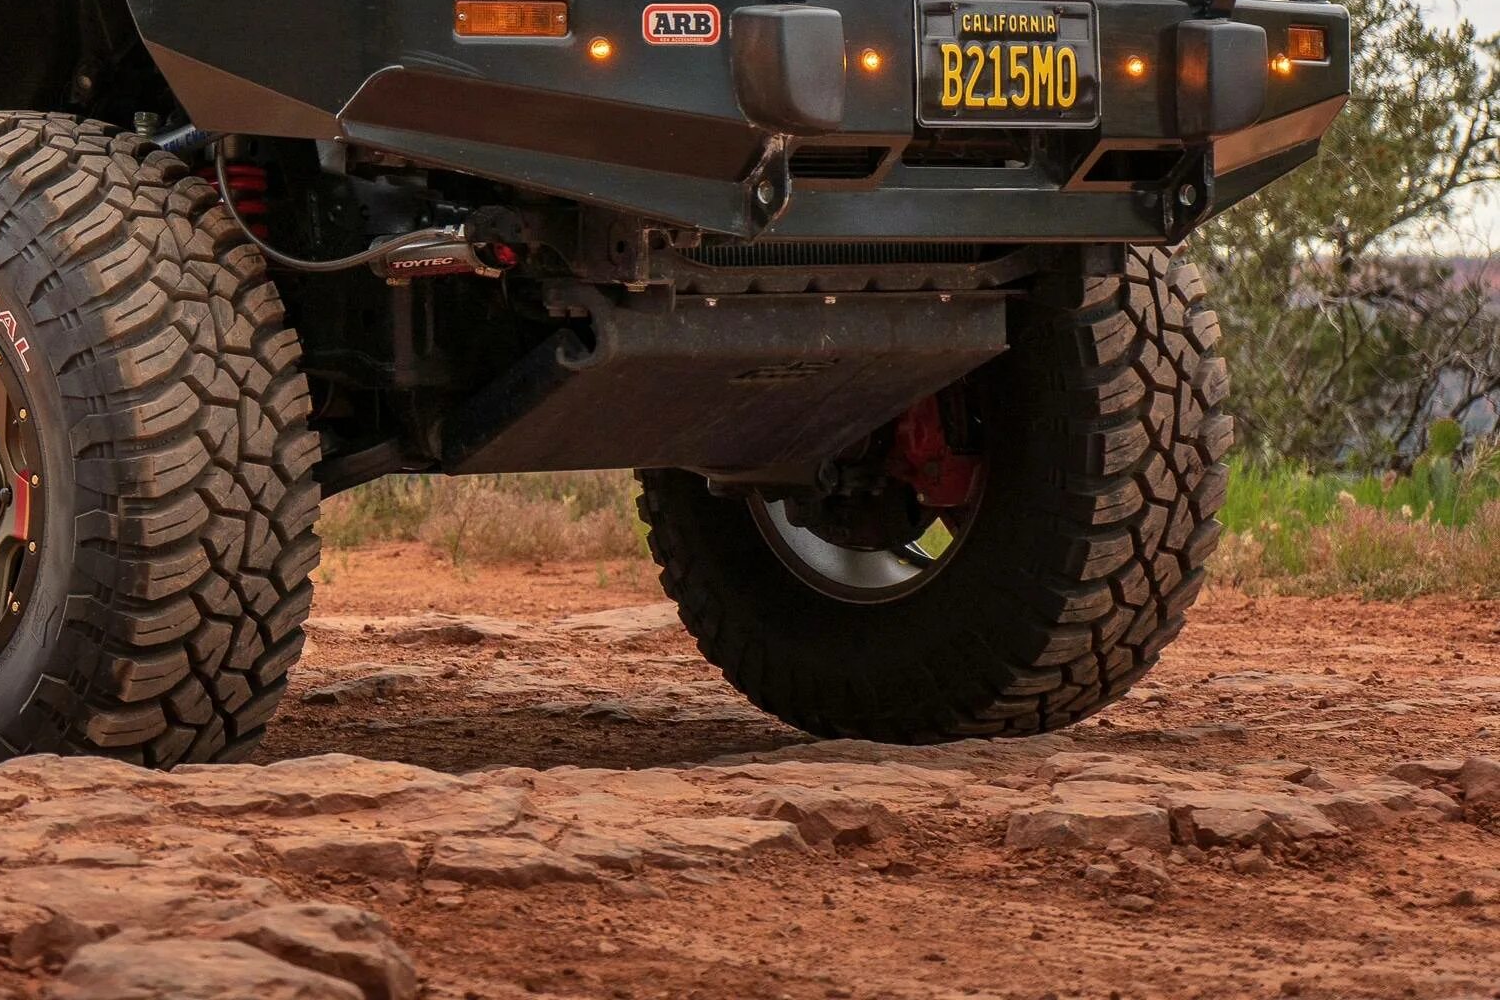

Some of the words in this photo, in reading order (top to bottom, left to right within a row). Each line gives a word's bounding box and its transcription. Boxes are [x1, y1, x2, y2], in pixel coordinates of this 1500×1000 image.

[653, 13, 711, 34] ARB
[962, 14, 1056, 33] CALIFORNIA
[393, 257, 453, 268] TOYTEC
